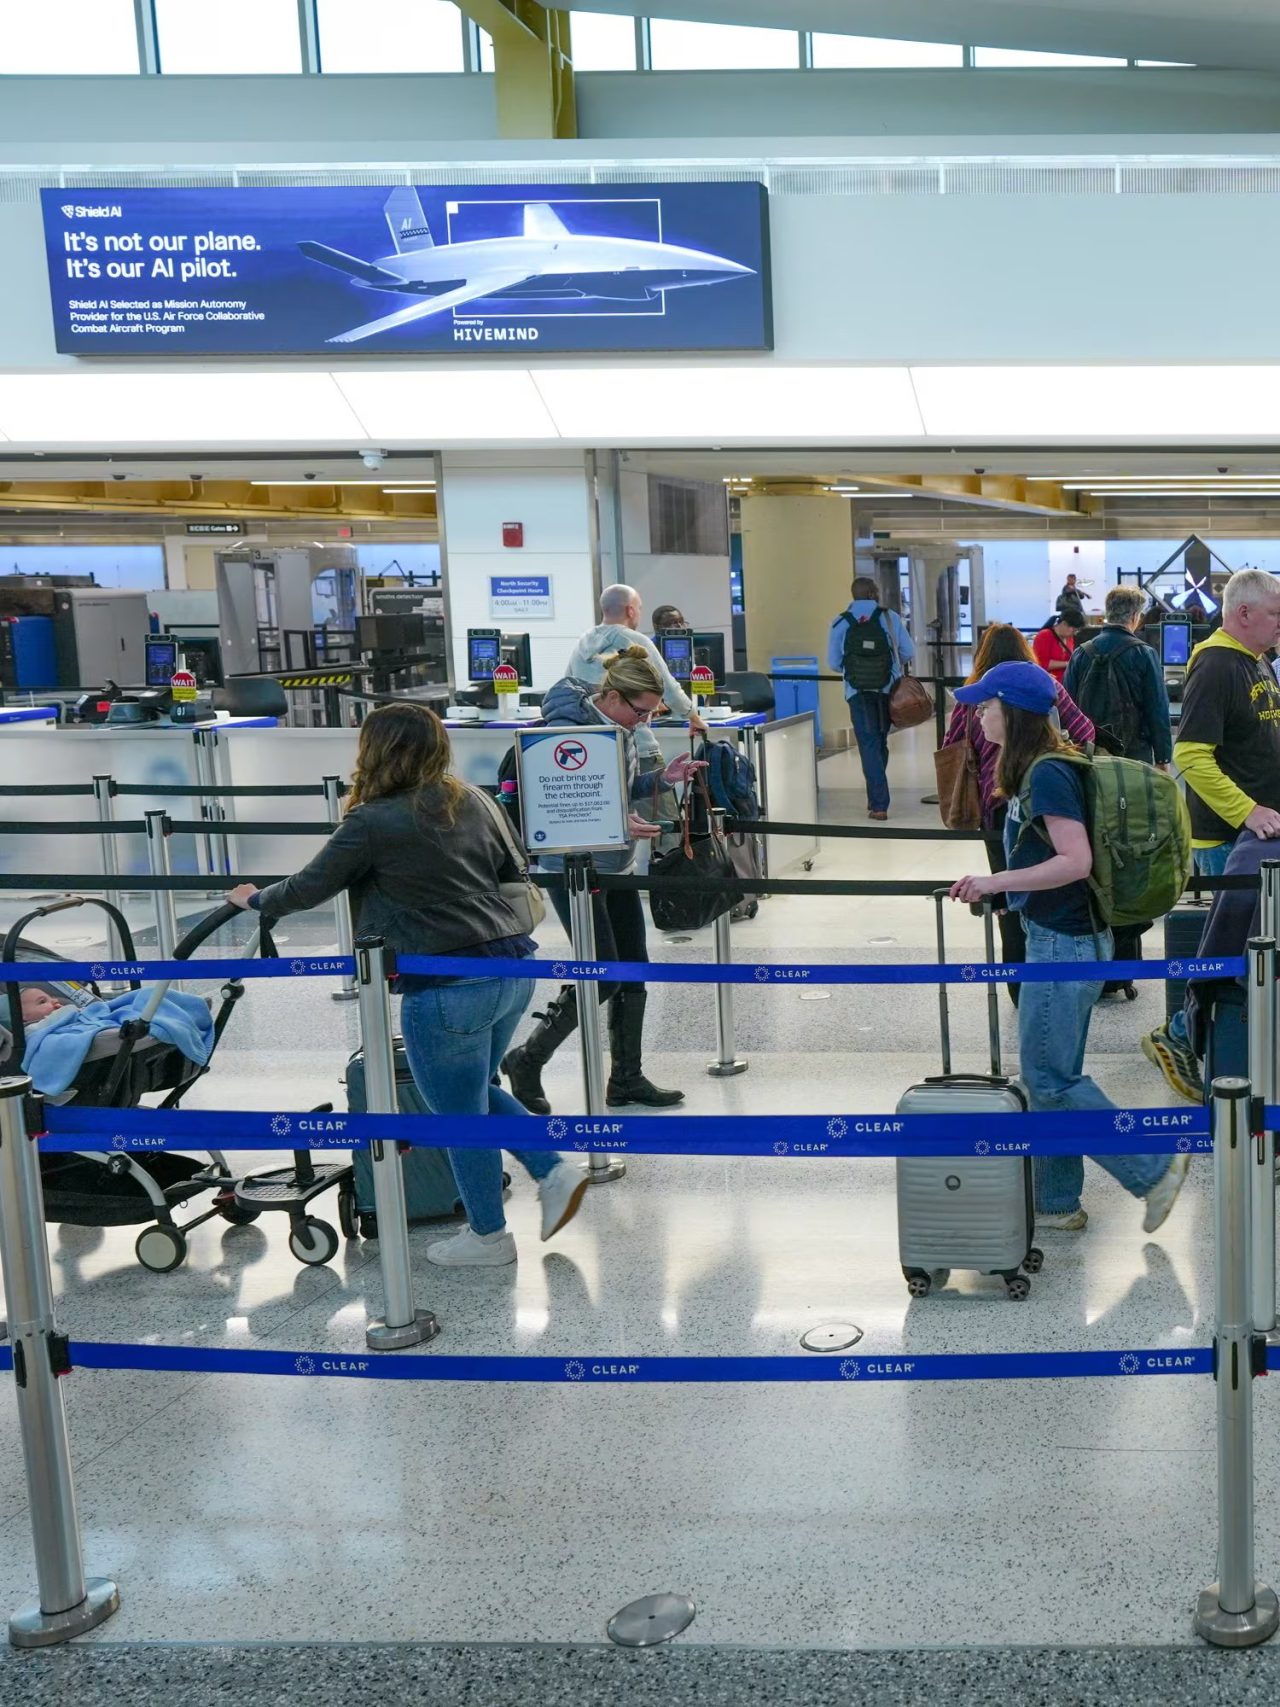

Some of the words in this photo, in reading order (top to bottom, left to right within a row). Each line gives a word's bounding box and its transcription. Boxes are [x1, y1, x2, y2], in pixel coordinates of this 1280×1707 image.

[75, 206, 109, 218] Shield
[110, 206, 122, 218] AI
[64, 231, 98, 251] It's
[104, 232, 144, 251] not
[149, 235, 188, 251] our
[194, 231, 261, 255] plane.
[66, 258, 101, 278] It's
[107, 261, 145, 278] our
[151, 258, 174, 278] AI
[181, 257, 237, 282] pilot.
[69, 300, 97, 310] Shield
[98, 300, 108, 309] AI
[110, 300, 150, 309] Selected
[164, 299, 199, 309] Mission
[200, 300, 246, 311] Autonomy
[70, 312, 109, 321] Provider
[111, 312, 125, 321] for
[126, 312, 142, 321] the
[163, 312, 176, 321] Air
[177, 312, 204, 321] Force
[206, 311, 265, 321] Collaborative
[71, 324, 108, 333] Combat
[109, 323, 144, 333] Aircraft
[145, 324, 185, 335] Program
[453, 328, 539, 341] HIVEMIND
[538, 775, 551, 783] Do
[551, 774, 565, 782] not
[565, 774, 587, 782] bring
[587, 774, 606, 782] your
[542, 783, 572, 791] firearm
[573, 781, 604, 790] through
[544, 792, 558, 800] the
